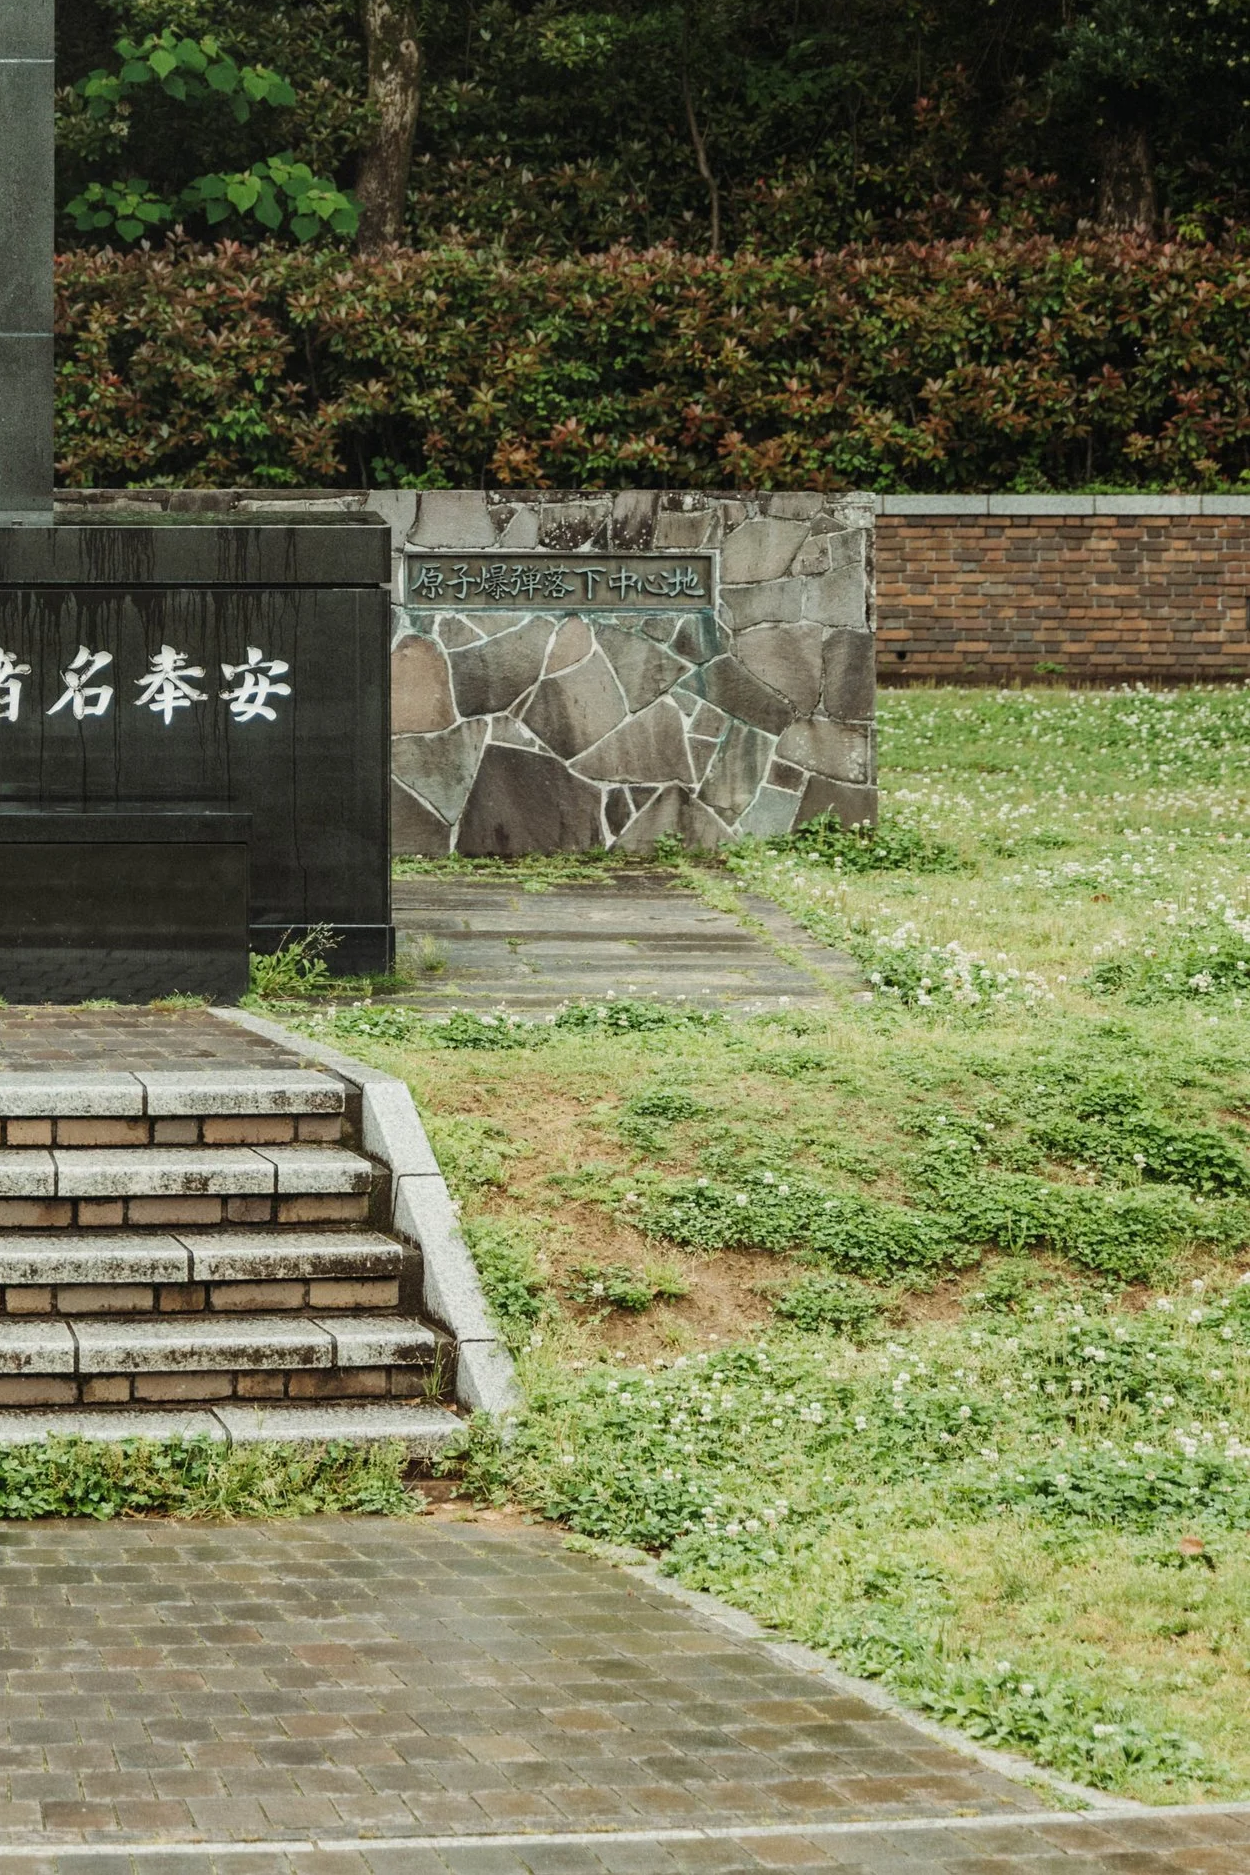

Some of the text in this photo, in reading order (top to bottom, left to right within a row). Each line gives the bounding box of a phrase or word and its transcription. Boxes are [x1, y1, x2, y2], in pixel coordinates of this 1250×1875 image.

[411, 563, 706, 601] 原子爆弾落下中心地
